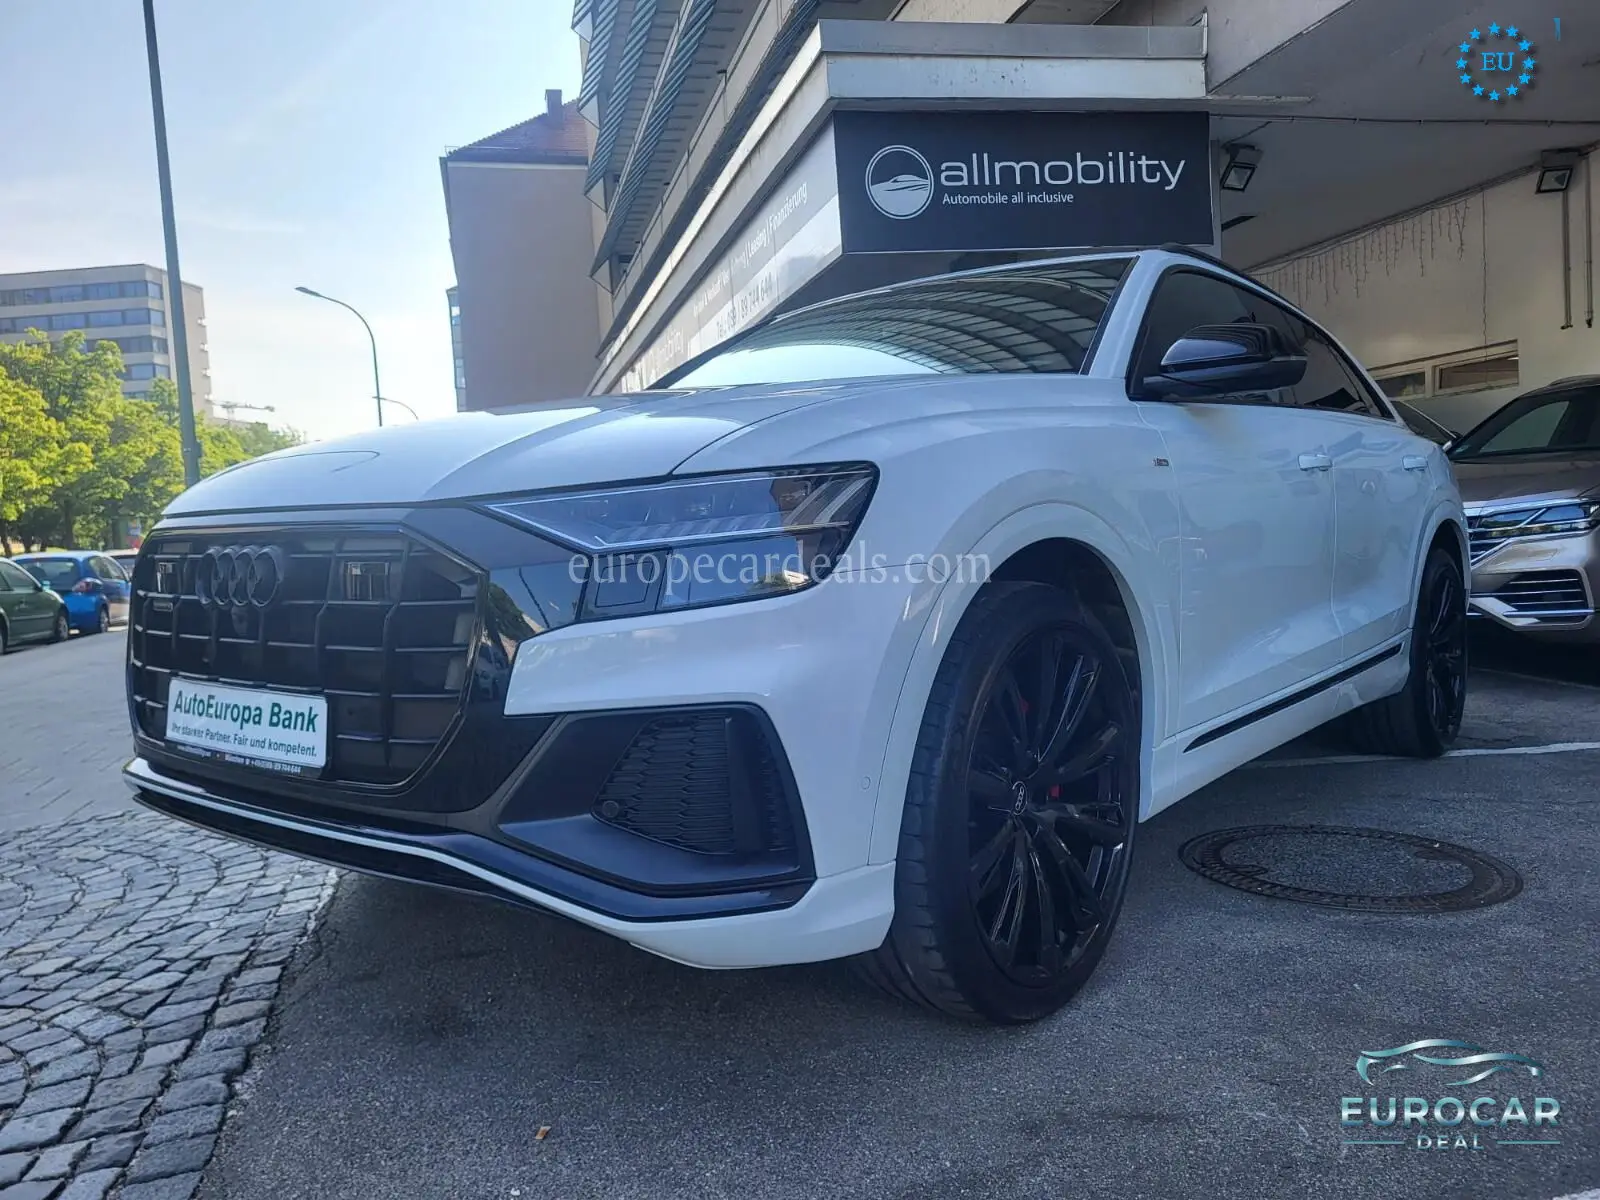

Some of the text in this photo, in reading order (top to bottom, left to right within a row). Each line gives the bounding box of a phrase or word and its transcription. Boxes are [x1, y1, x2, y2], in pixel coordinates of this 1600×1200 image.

[940, 151, 1186, 191] allmobility
[942, 191, 1074, 205] Automobile all inclusive
[173, 690, 319, 733] AutoEuropa Bank
[172, 722, 181, 733] Ihr
[205, 729, 232, 744] Partner.
[233, 733, 248, 747] Fair
[250, 736, 266, 749] und
[267, 738, 317, 757] kompetent.
